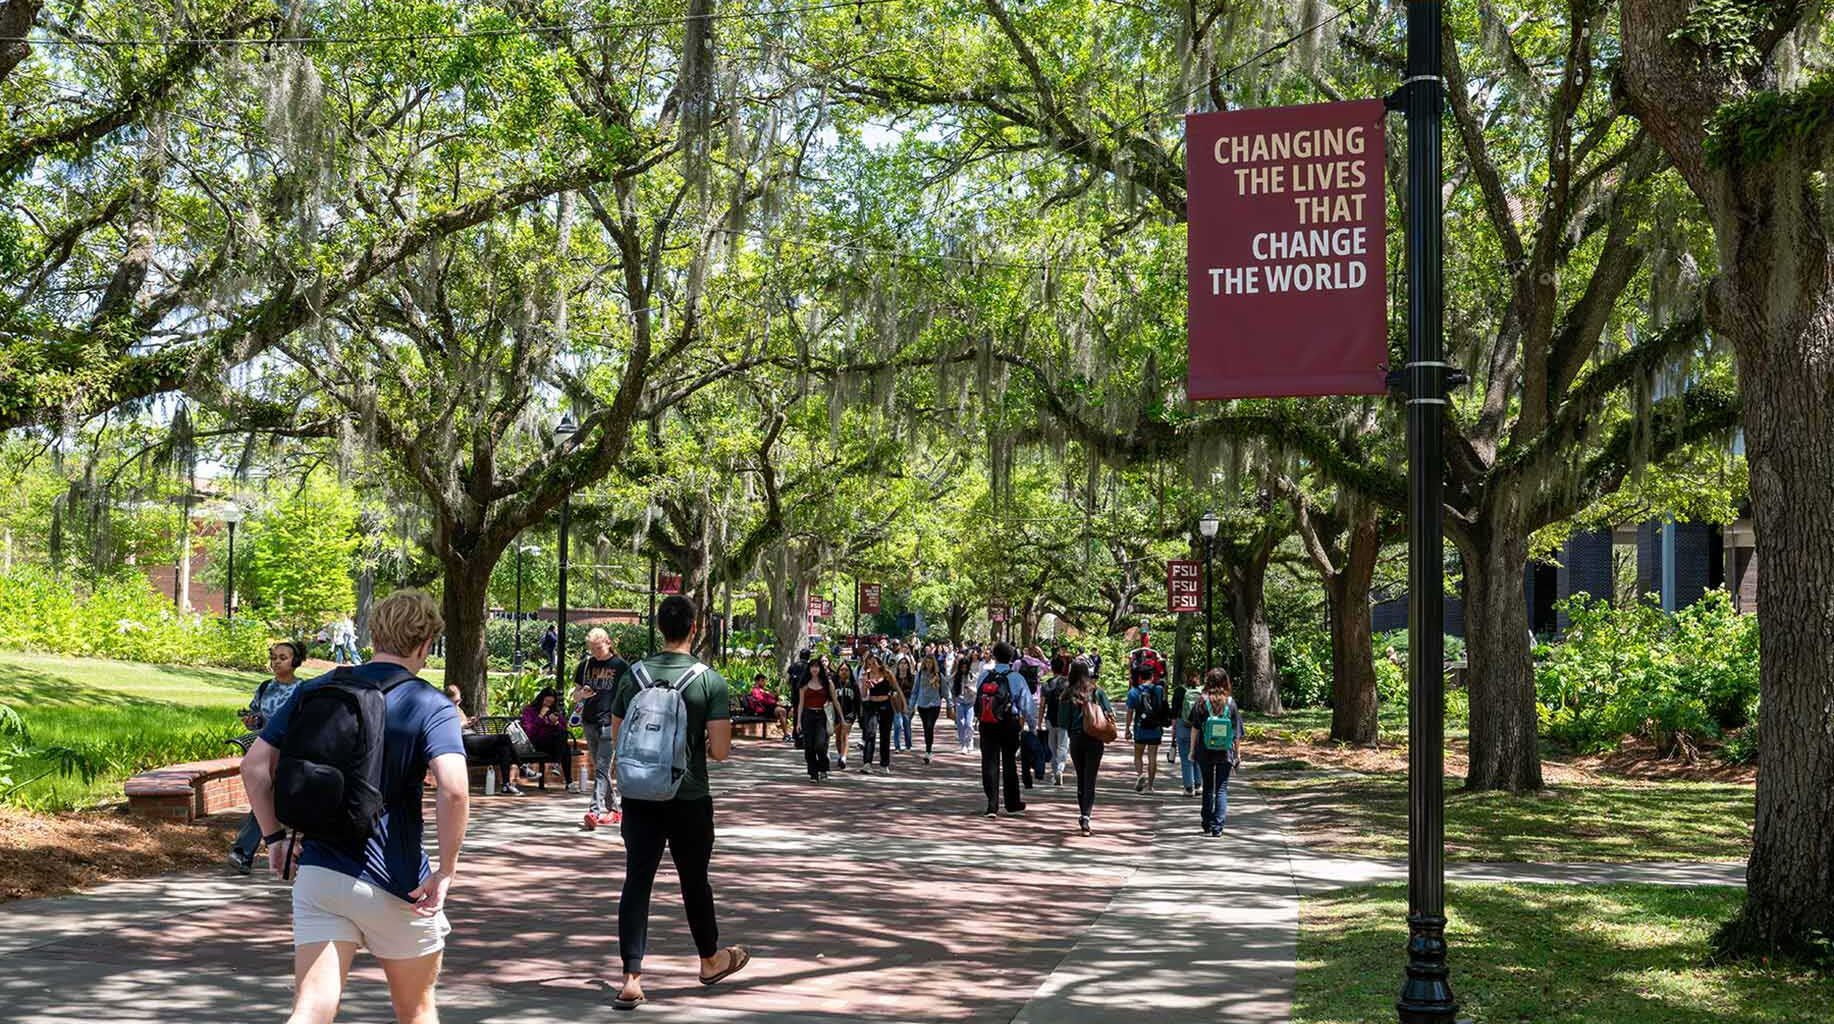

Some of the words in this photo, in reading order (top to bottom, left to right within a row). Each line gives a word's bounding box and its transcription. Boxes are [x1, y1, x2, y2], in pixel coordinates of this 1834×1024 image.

[1214, 126, 1365, 164] CHANGING
[1234, 166, 1285, 195] THE
[1293, 160, 1367, 192] LIVES
[1295, 194, 1367, 225] THAT
[1252, 227, 1367, 260] CHANGE
[1208, 267, 1260, 295] THE
[1265, 261, 1367, 292] WORLD
[1172, 565, 1197, 577] FSU
[1172, 580, 1197, 592] FSU
[1172, 595, 1197, 607] FSU
